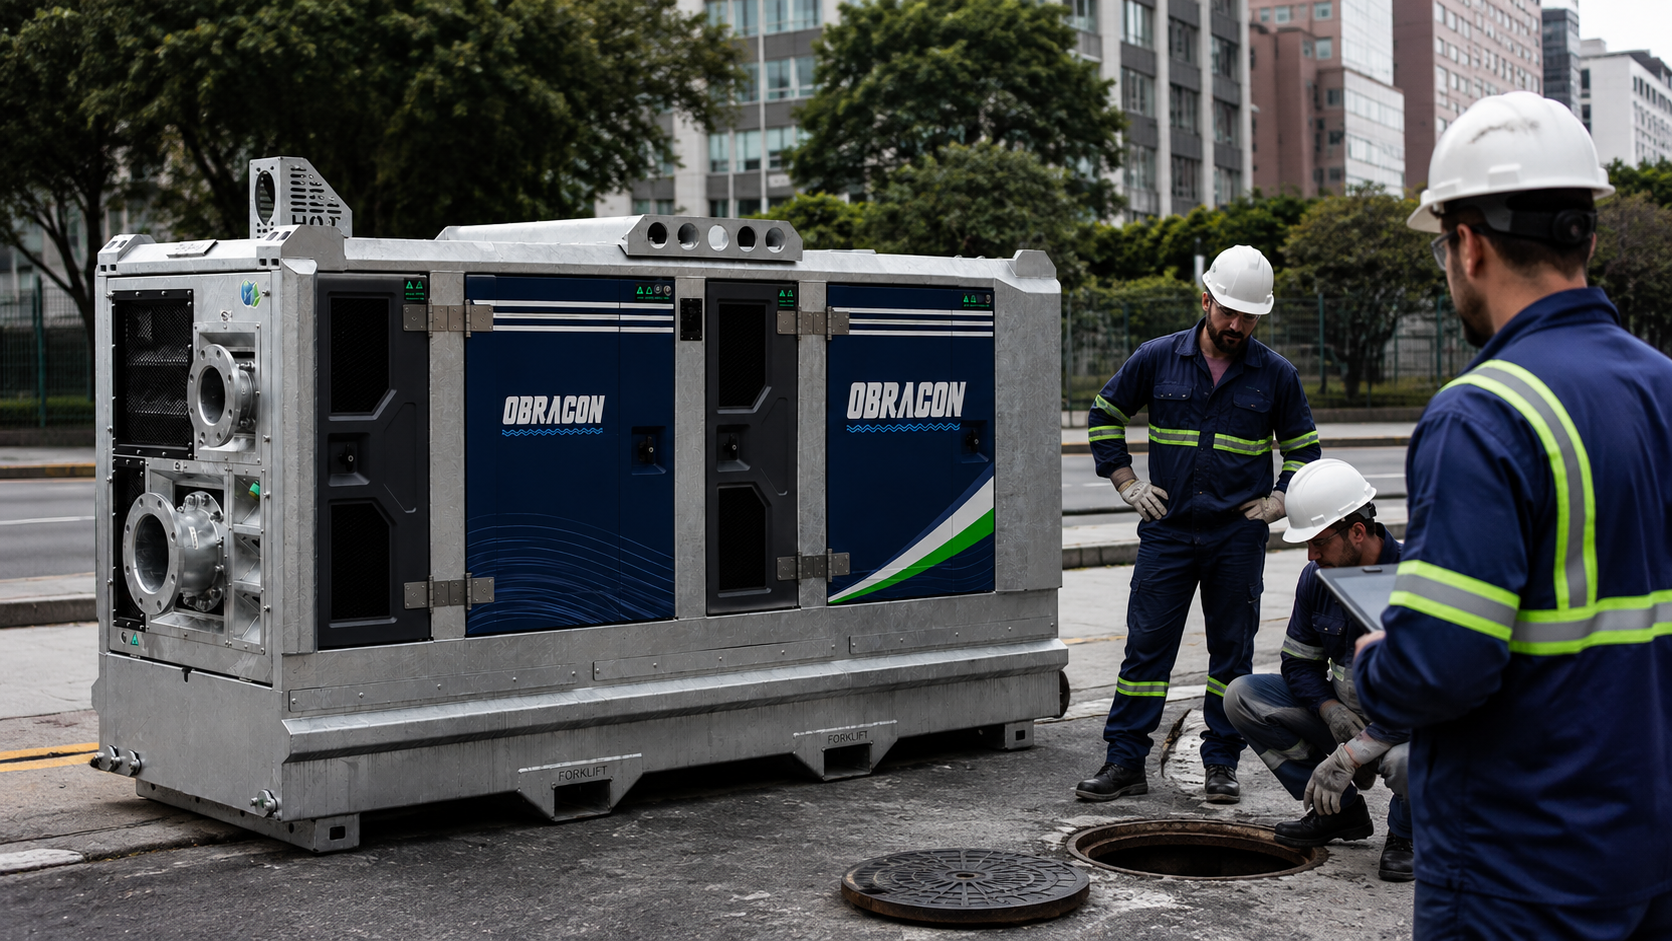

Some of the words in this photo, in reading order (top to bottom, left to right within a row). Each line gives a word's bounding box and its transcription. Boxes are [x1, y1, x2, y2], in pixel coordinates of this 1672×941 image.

[502, 395, 606, 425] OBRACON
[846, 381, 967, 420] OBRACON
[827, 730, 868, 745] FORKLIFT
[558, 765, 608, 782] FORKLIFT
